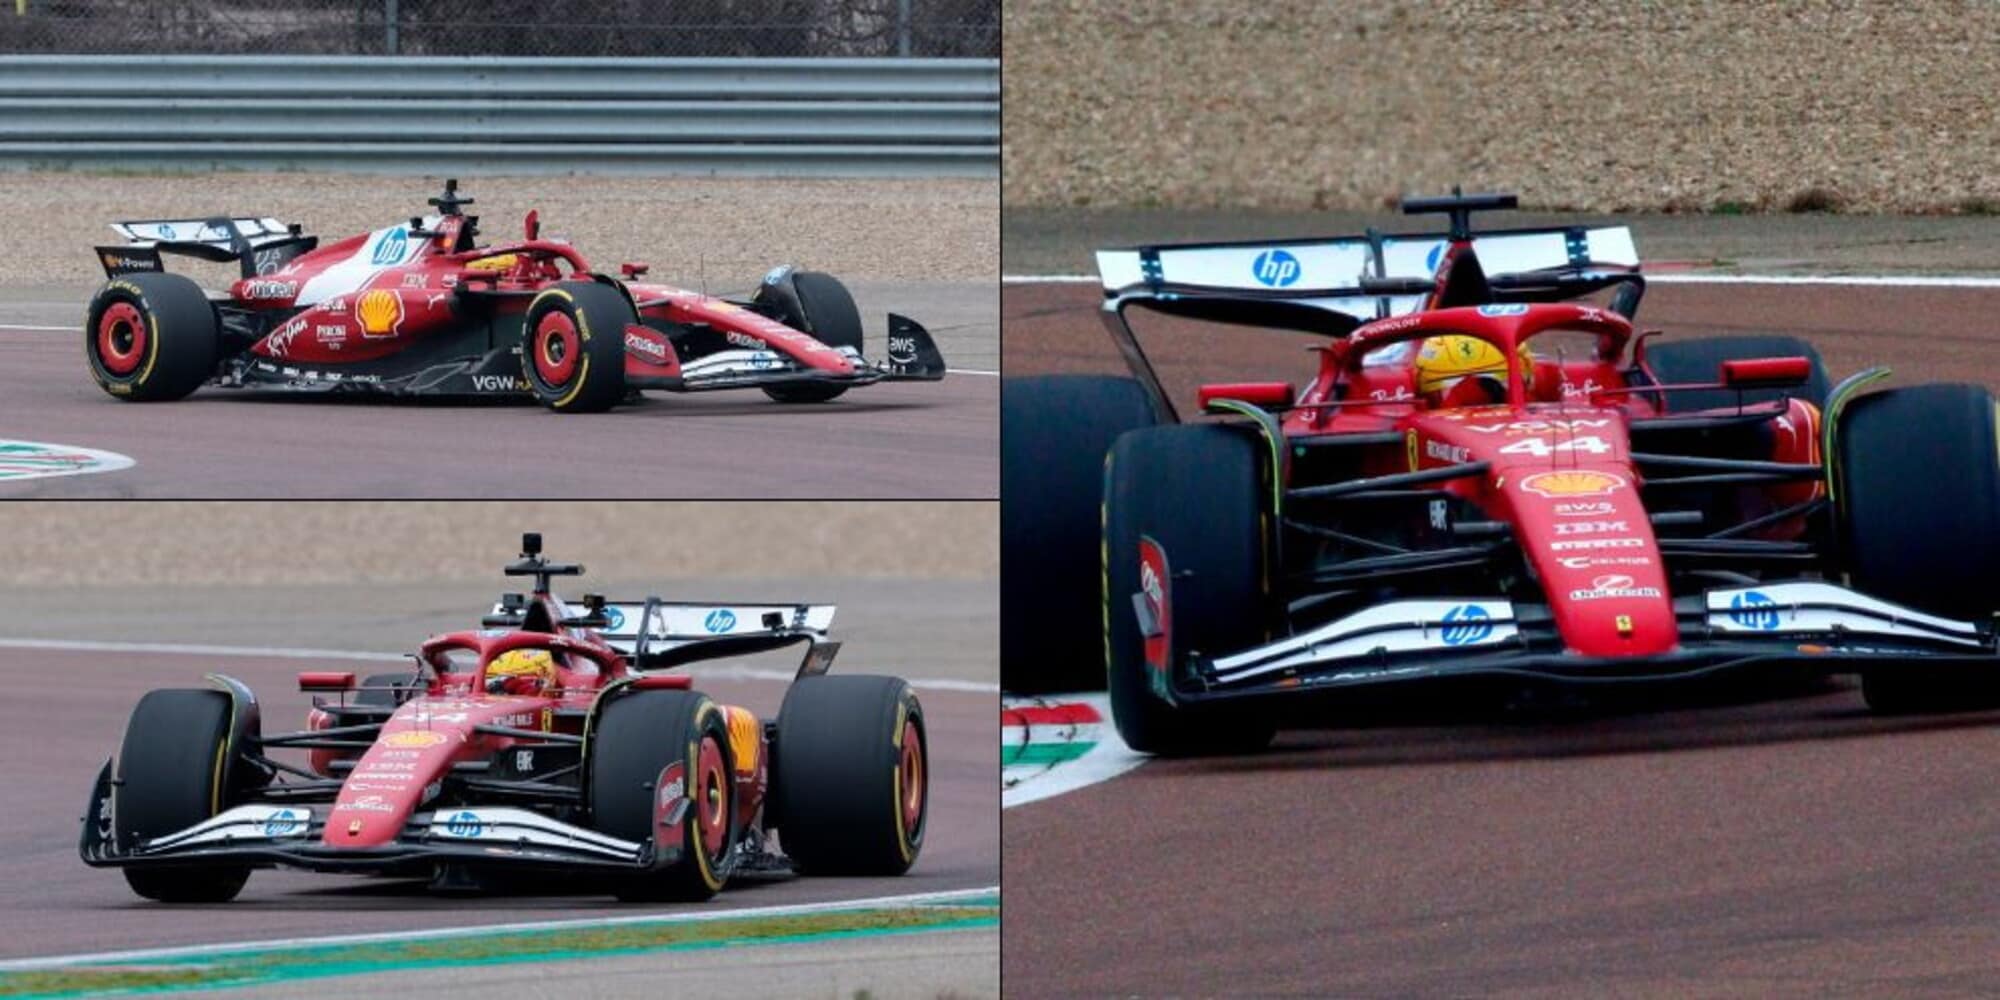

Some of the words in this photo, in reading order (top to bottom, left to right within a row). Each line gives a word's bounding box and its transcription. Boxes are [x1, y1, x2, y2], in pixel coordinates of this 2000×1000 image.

[371, 227, 407, 264] hp
[1252, 249, 1301, 288] hp
[472, 376, 514, 391] VGW
[1499, 435, 1612, 456] 44
[1553, 521, 1629, 534] IBM
[705, 609, 736, 633] hp
[1729, 591, 1781, 630] hp
[1441, 604, 1494, 645] hp
[448, 811, 482, 838] hp
